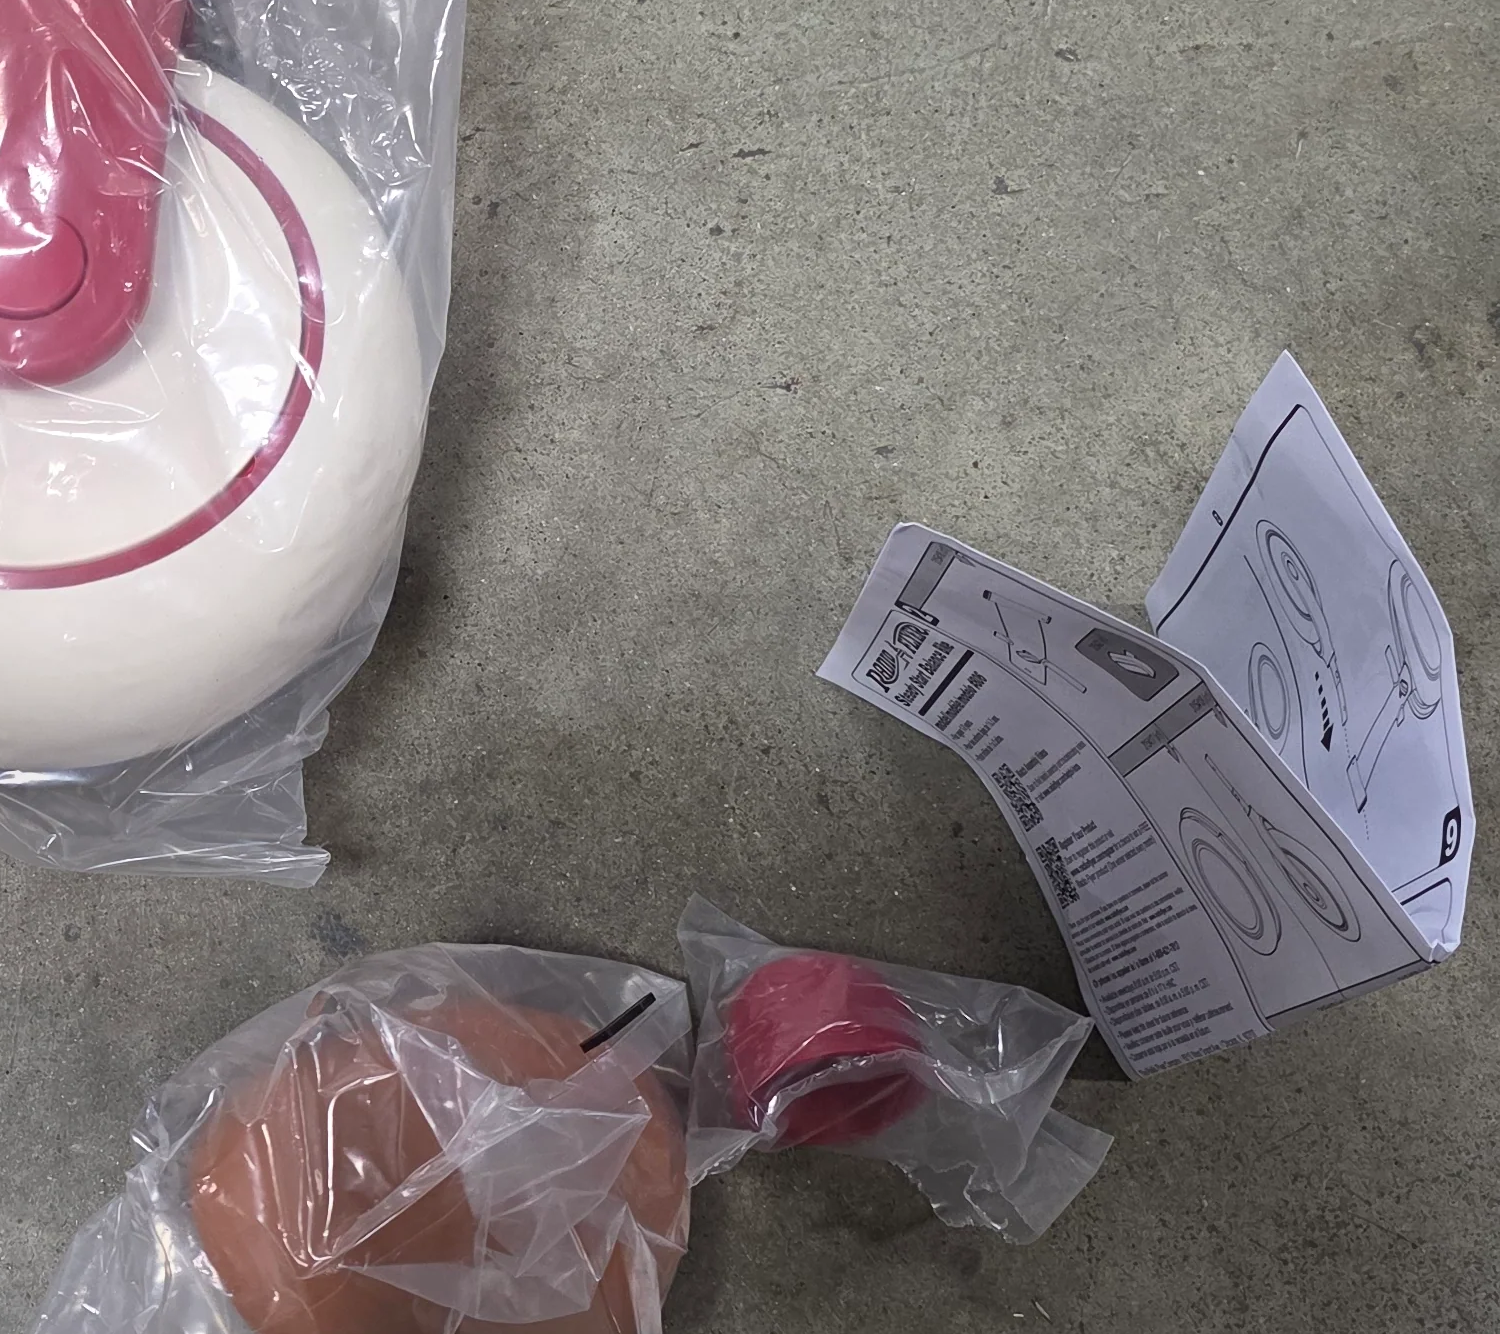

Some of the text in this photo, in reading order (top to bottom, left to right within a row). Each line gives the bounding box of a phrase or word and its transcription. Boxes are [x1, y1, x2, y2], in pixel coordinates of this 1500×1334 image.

[917, 649, 947, 676] Balance
[908, 669, 931, 689] Start
[894, 682, 924, 707] Steady
